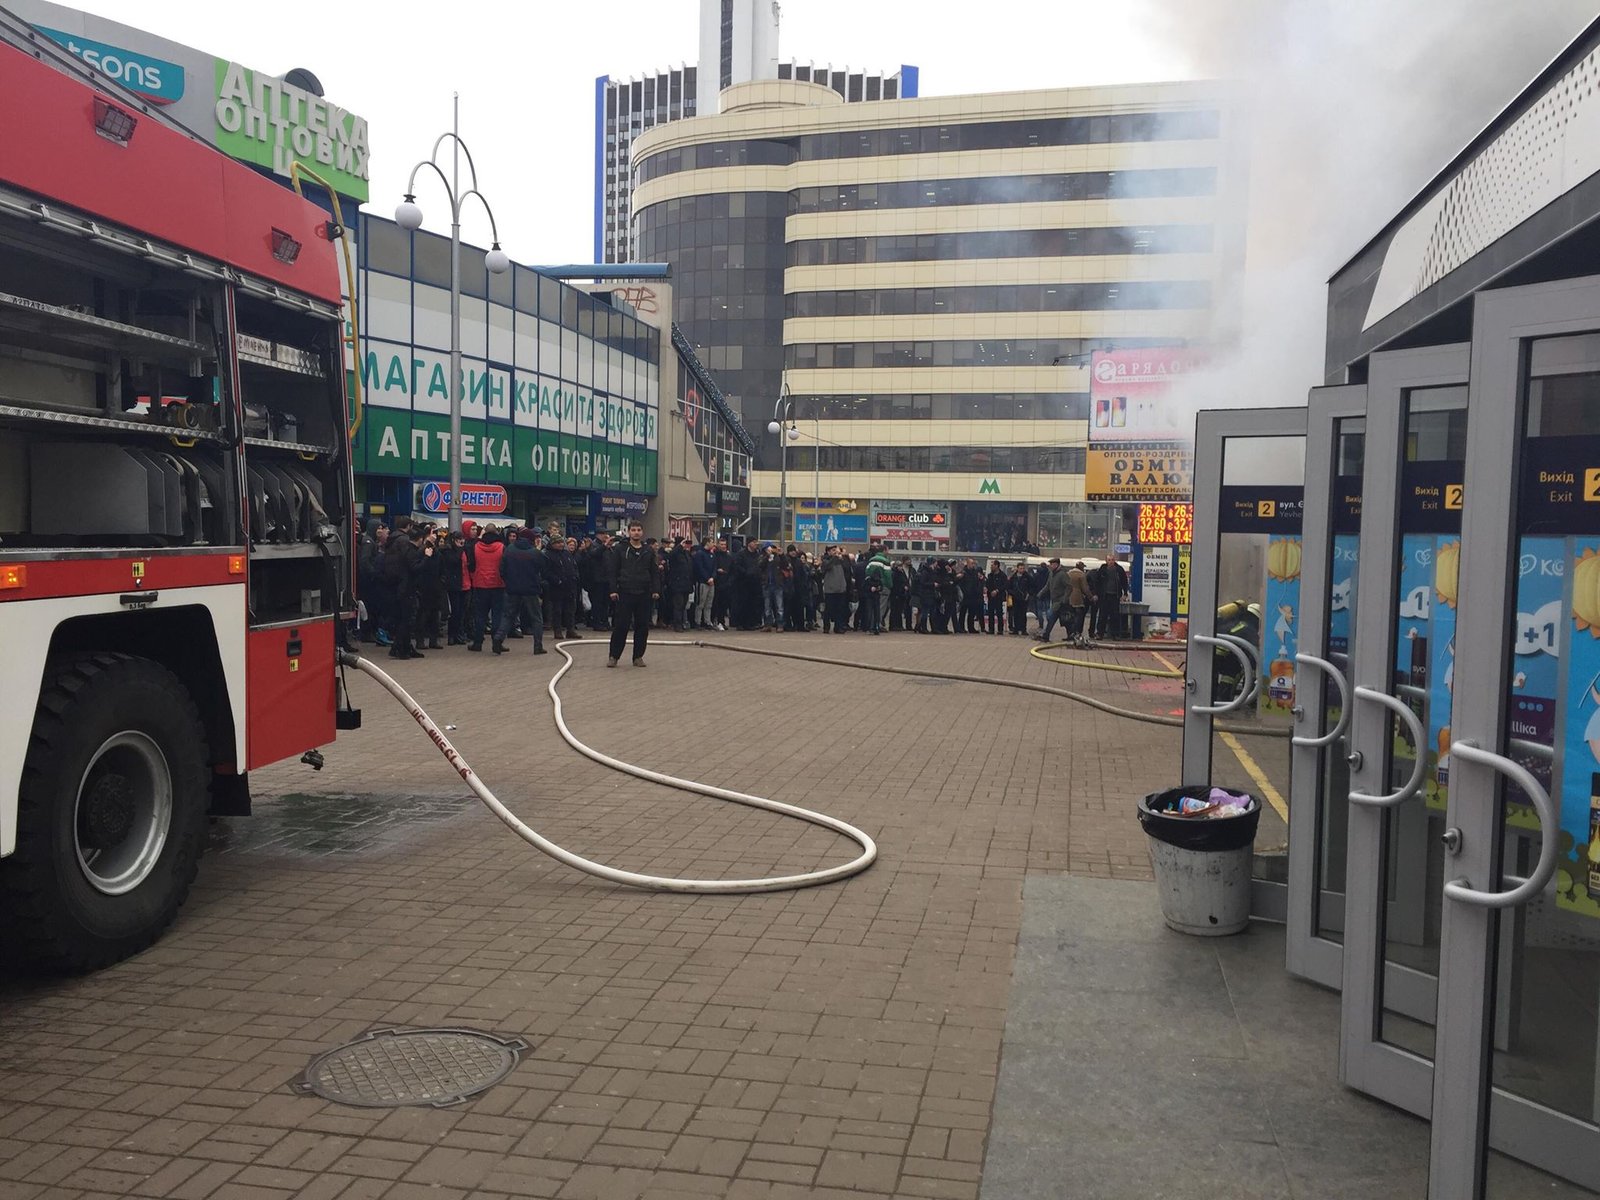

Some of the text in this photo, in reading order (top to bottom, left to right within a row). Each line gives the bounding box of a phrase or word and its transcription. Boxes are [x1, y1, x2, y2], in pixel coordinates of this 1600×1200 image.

[219, 61, 368, 147] АПТЕКА
[215, 98, 370, 181] ОПТОВИХ
[515, 379, 574, 423] КРАСИ
[378, 425, 630, 482] АПТЕКА ОПТОВИХ Ц
[1540, 470, 1575, 483] Вихід
[443, 490, 503, 507] ФРНЕТТІ
[1415, 486, 1461, 506] Вихід 2
[1550, 490, 1573, 502] Exit
[1140, 504, 1167, 517] 26.25
[1262, 503, 1270, 515] 2
[1422, 501, 1438, 509] Exit
[908, 513, 929, 523] club
[1140, 518, 1166, 530] 32.60
[1140, 530, 1164, 542] 0.453
